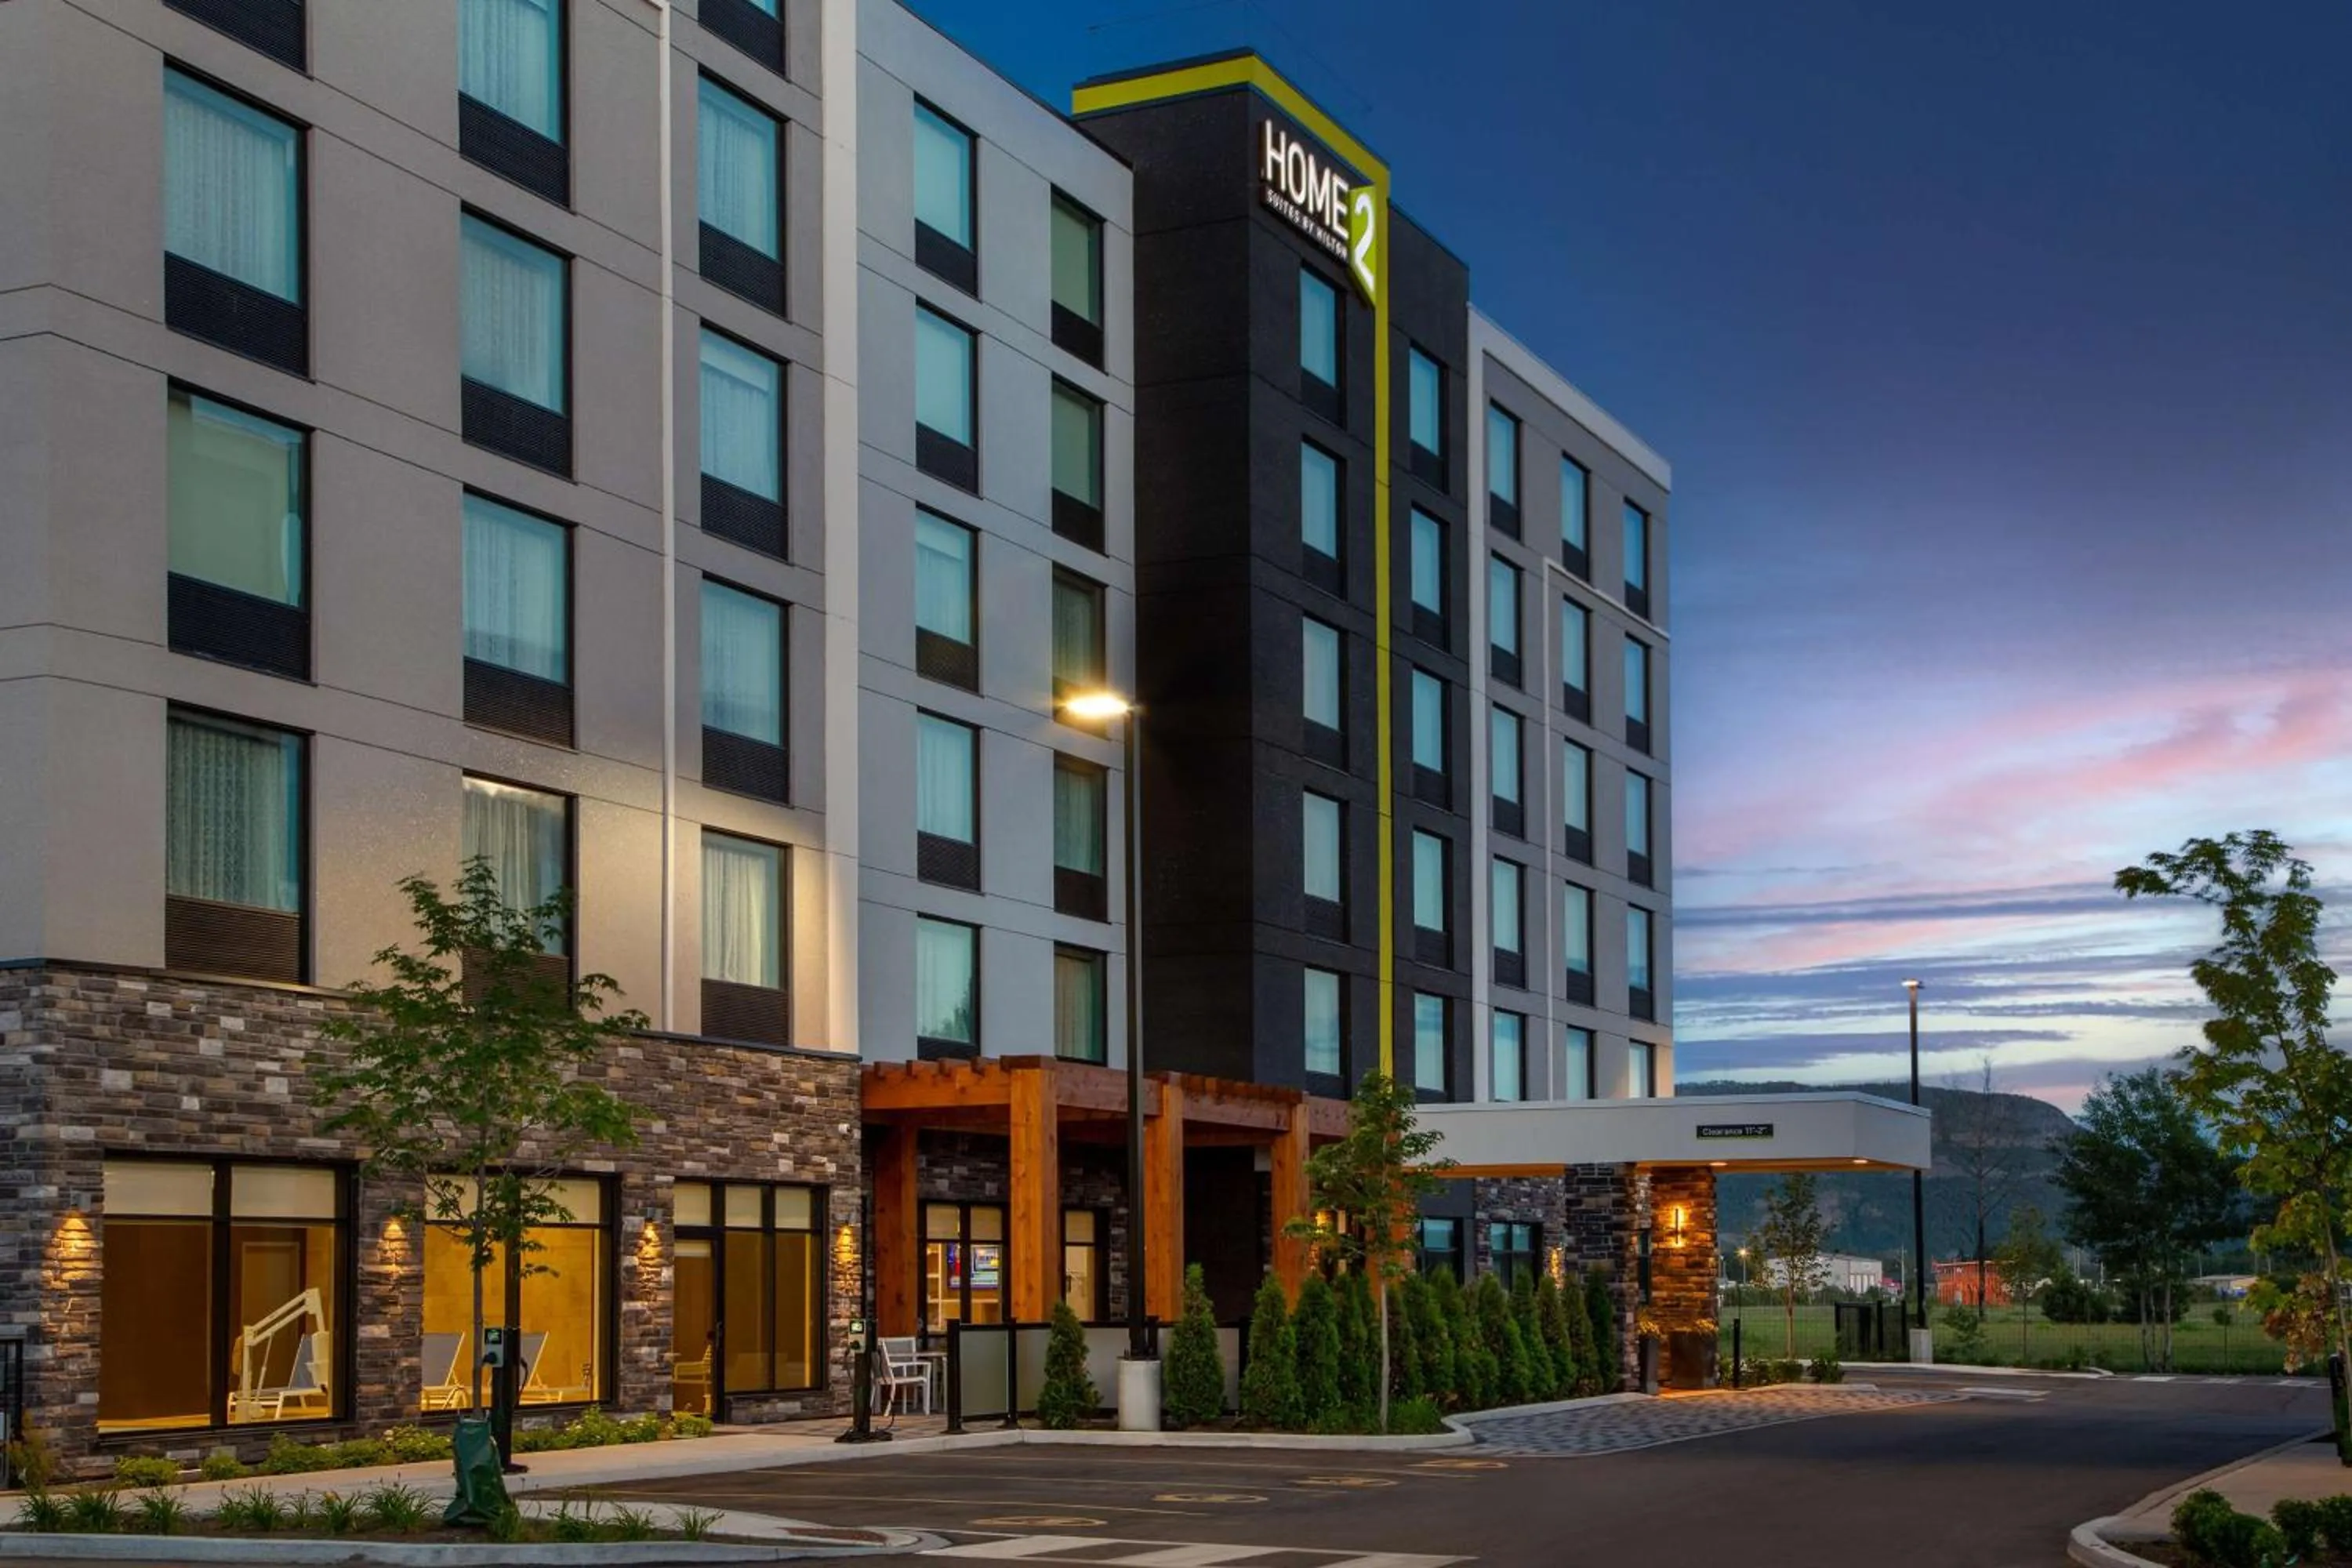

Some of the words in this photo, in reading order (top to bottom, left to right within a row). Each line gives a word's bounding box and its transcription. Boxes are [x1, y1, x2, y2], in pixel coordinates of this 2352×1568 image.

[1265, 119, 1349, 240] HOME
[1354, 193, 1375, 292] 2
[1267, 189, 1300, 224] SUITES
[1302, 216, 1315, 234] BY
[1316, 224, 1348, 261] HILTON
[1702, 1127, 1743, 1136] Clearance
